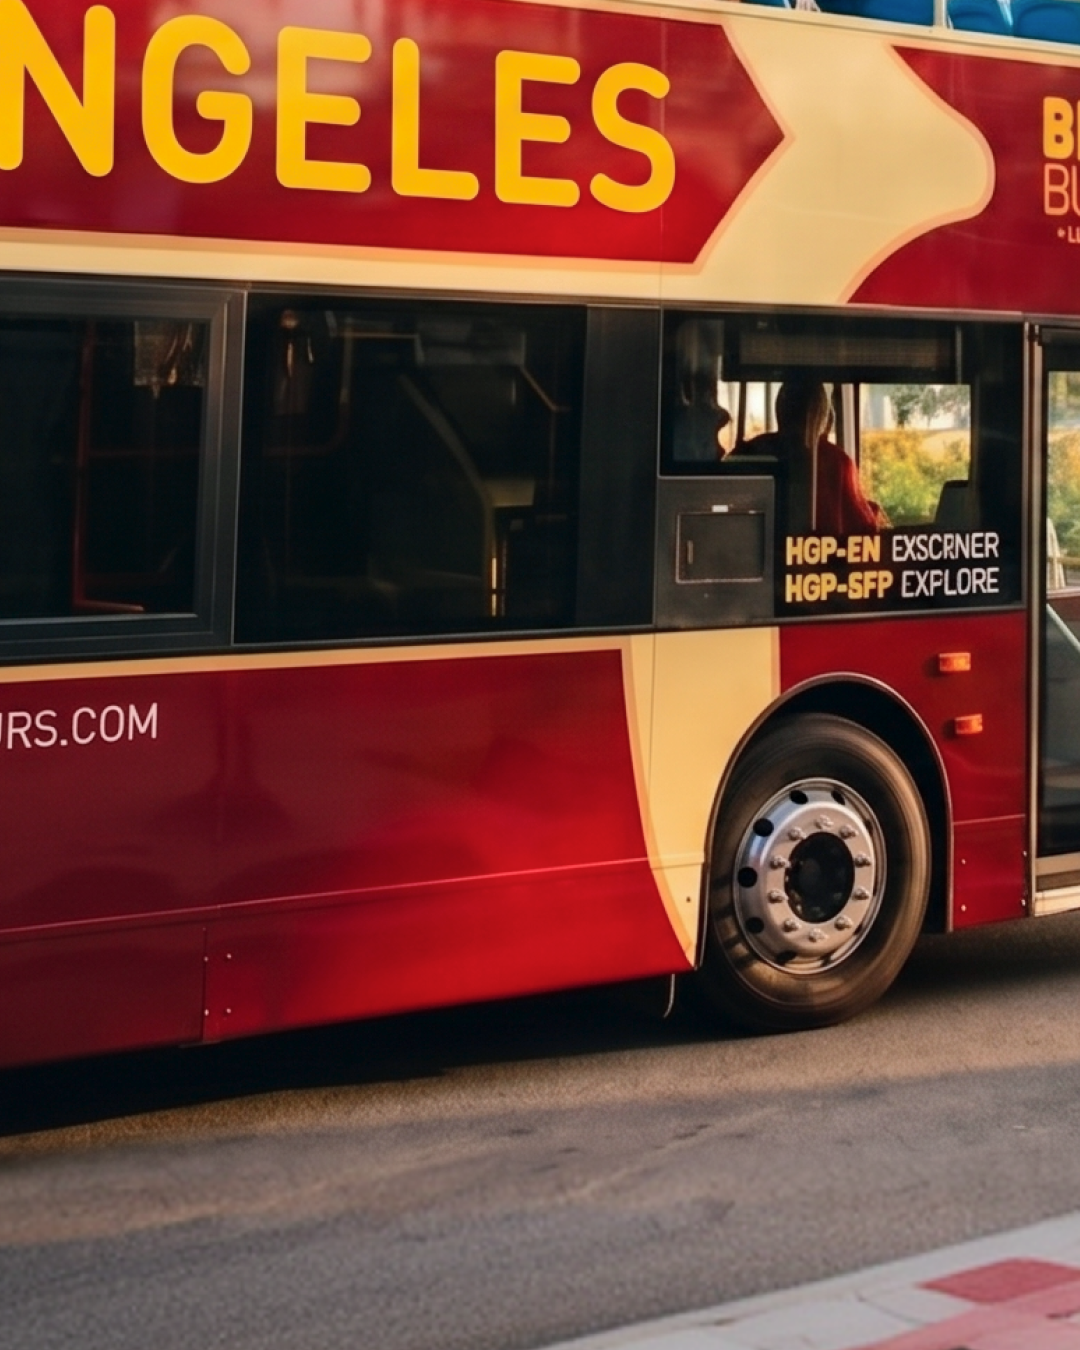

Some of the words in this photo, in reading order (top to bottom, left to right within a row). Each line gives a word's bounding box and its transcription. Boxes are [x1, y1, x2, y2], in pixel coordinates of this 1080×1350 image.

[785, 535, 881, 566] HGP-EN
[785, 570, 894, 603] HGP-SFP
[901, 566, 1000, 598] EXPLORE
[0, 702, 158, 750] RS.COM
